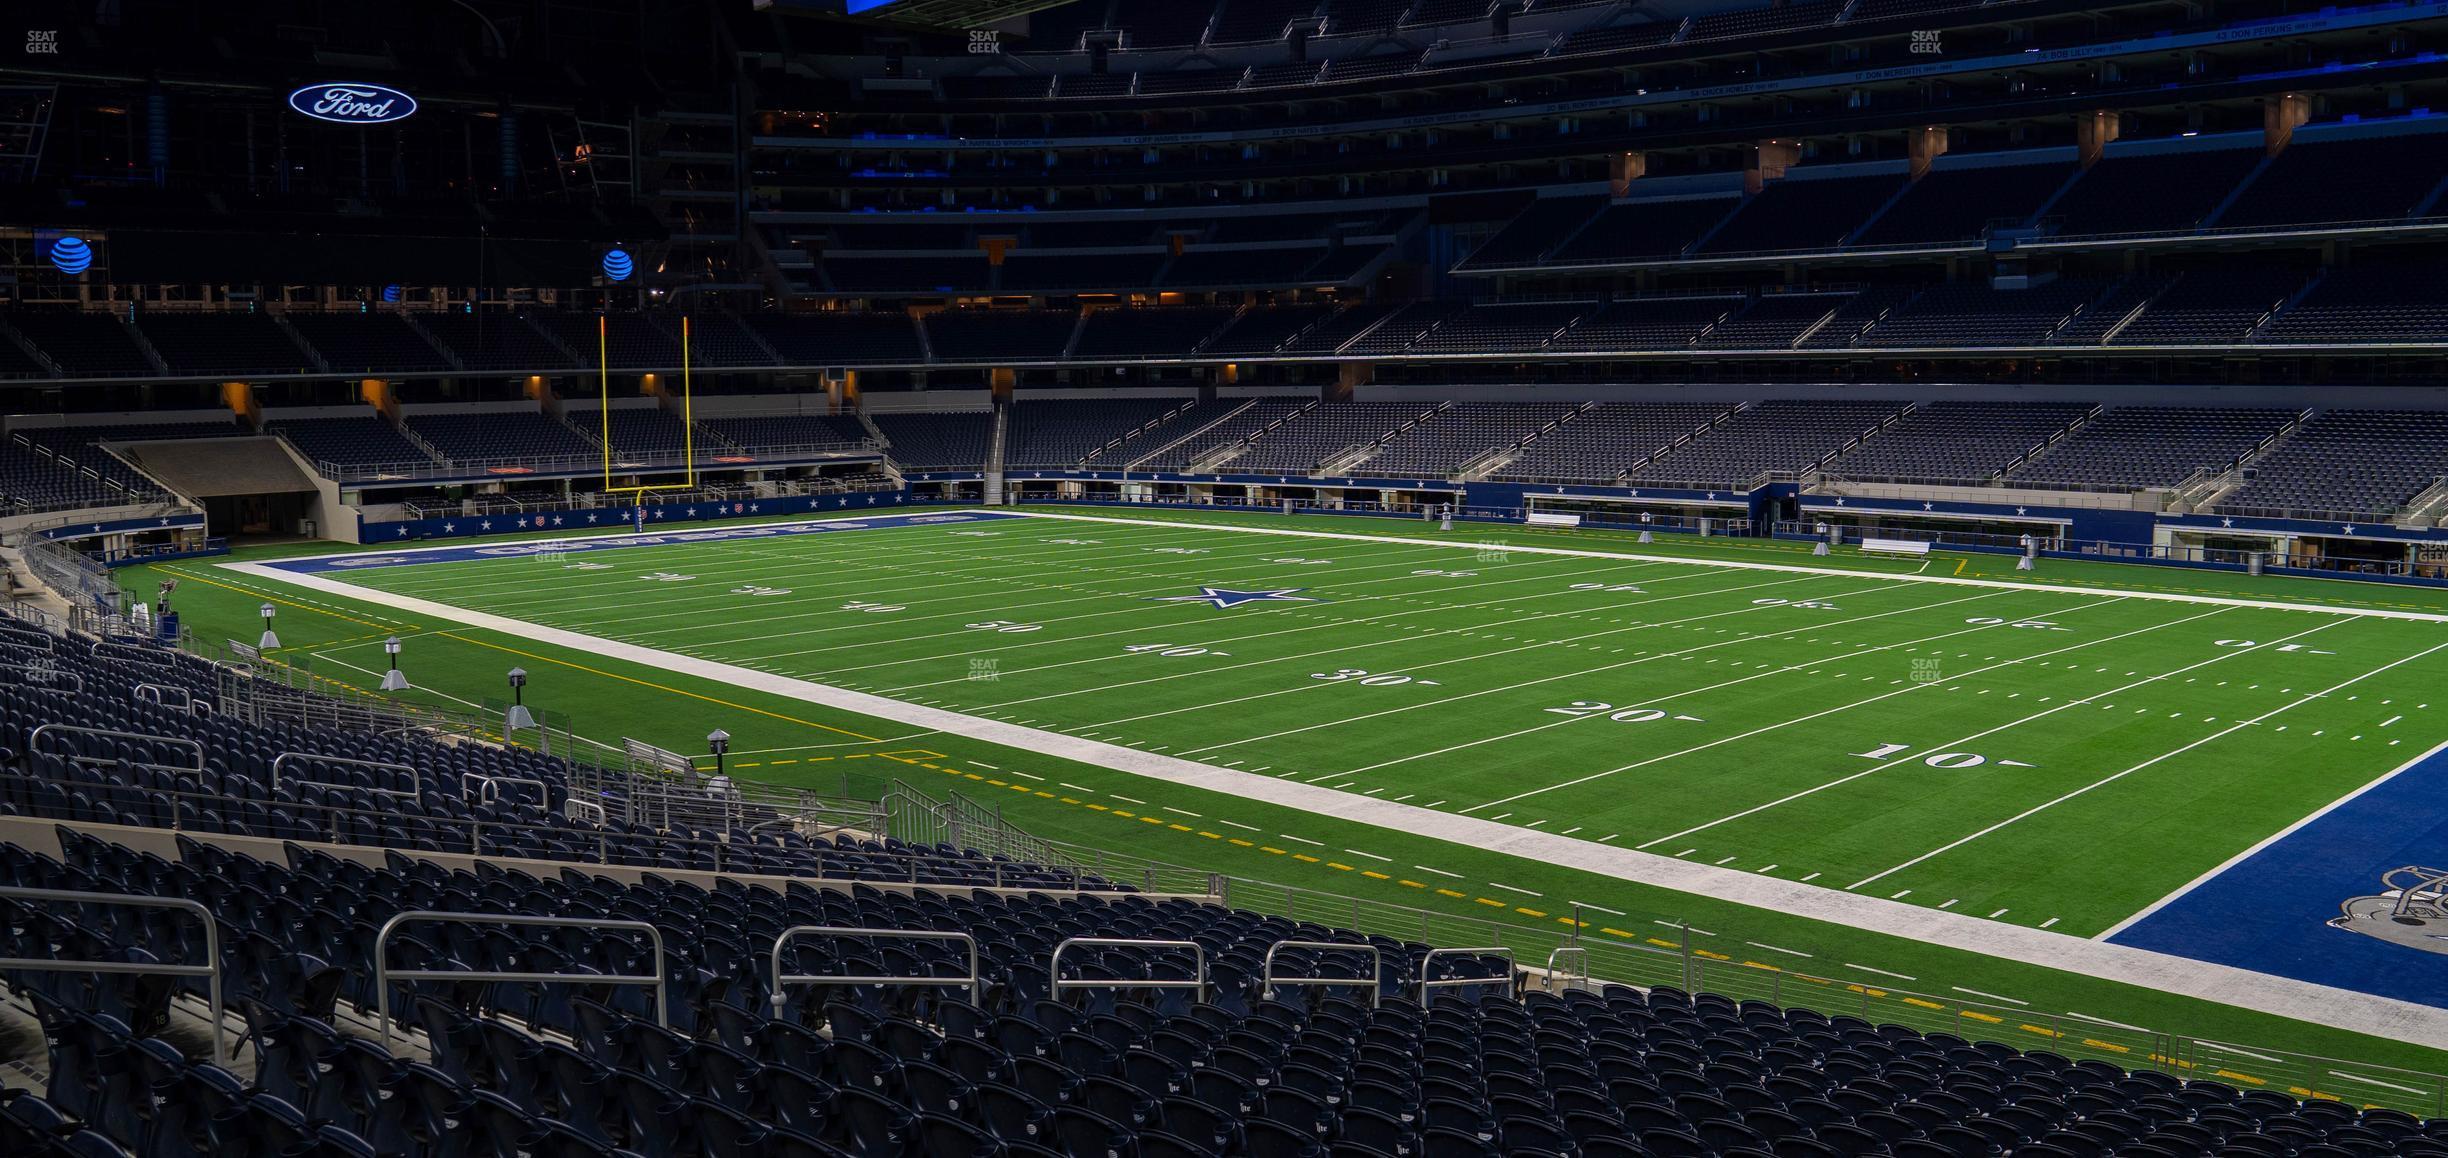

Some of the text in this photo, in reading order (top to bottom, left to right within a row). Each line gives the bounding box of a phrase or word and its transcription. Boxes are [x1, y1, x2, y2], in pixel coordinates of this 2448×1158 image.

[2231, 29, 2251, 40] DON
[2254, 22, 2293, 37] PERKINS
[314, 88, 395, 118] Ford
[964, 620, 1044, 633] 50
[1121, 643, 1209, 657] 40
[1309, 669, 1413, 686] 30
[1543, 700, 1667, 723] 20
[1847, 742, 1988, 769] 10
[155, 1014, 166, 1025] 18
